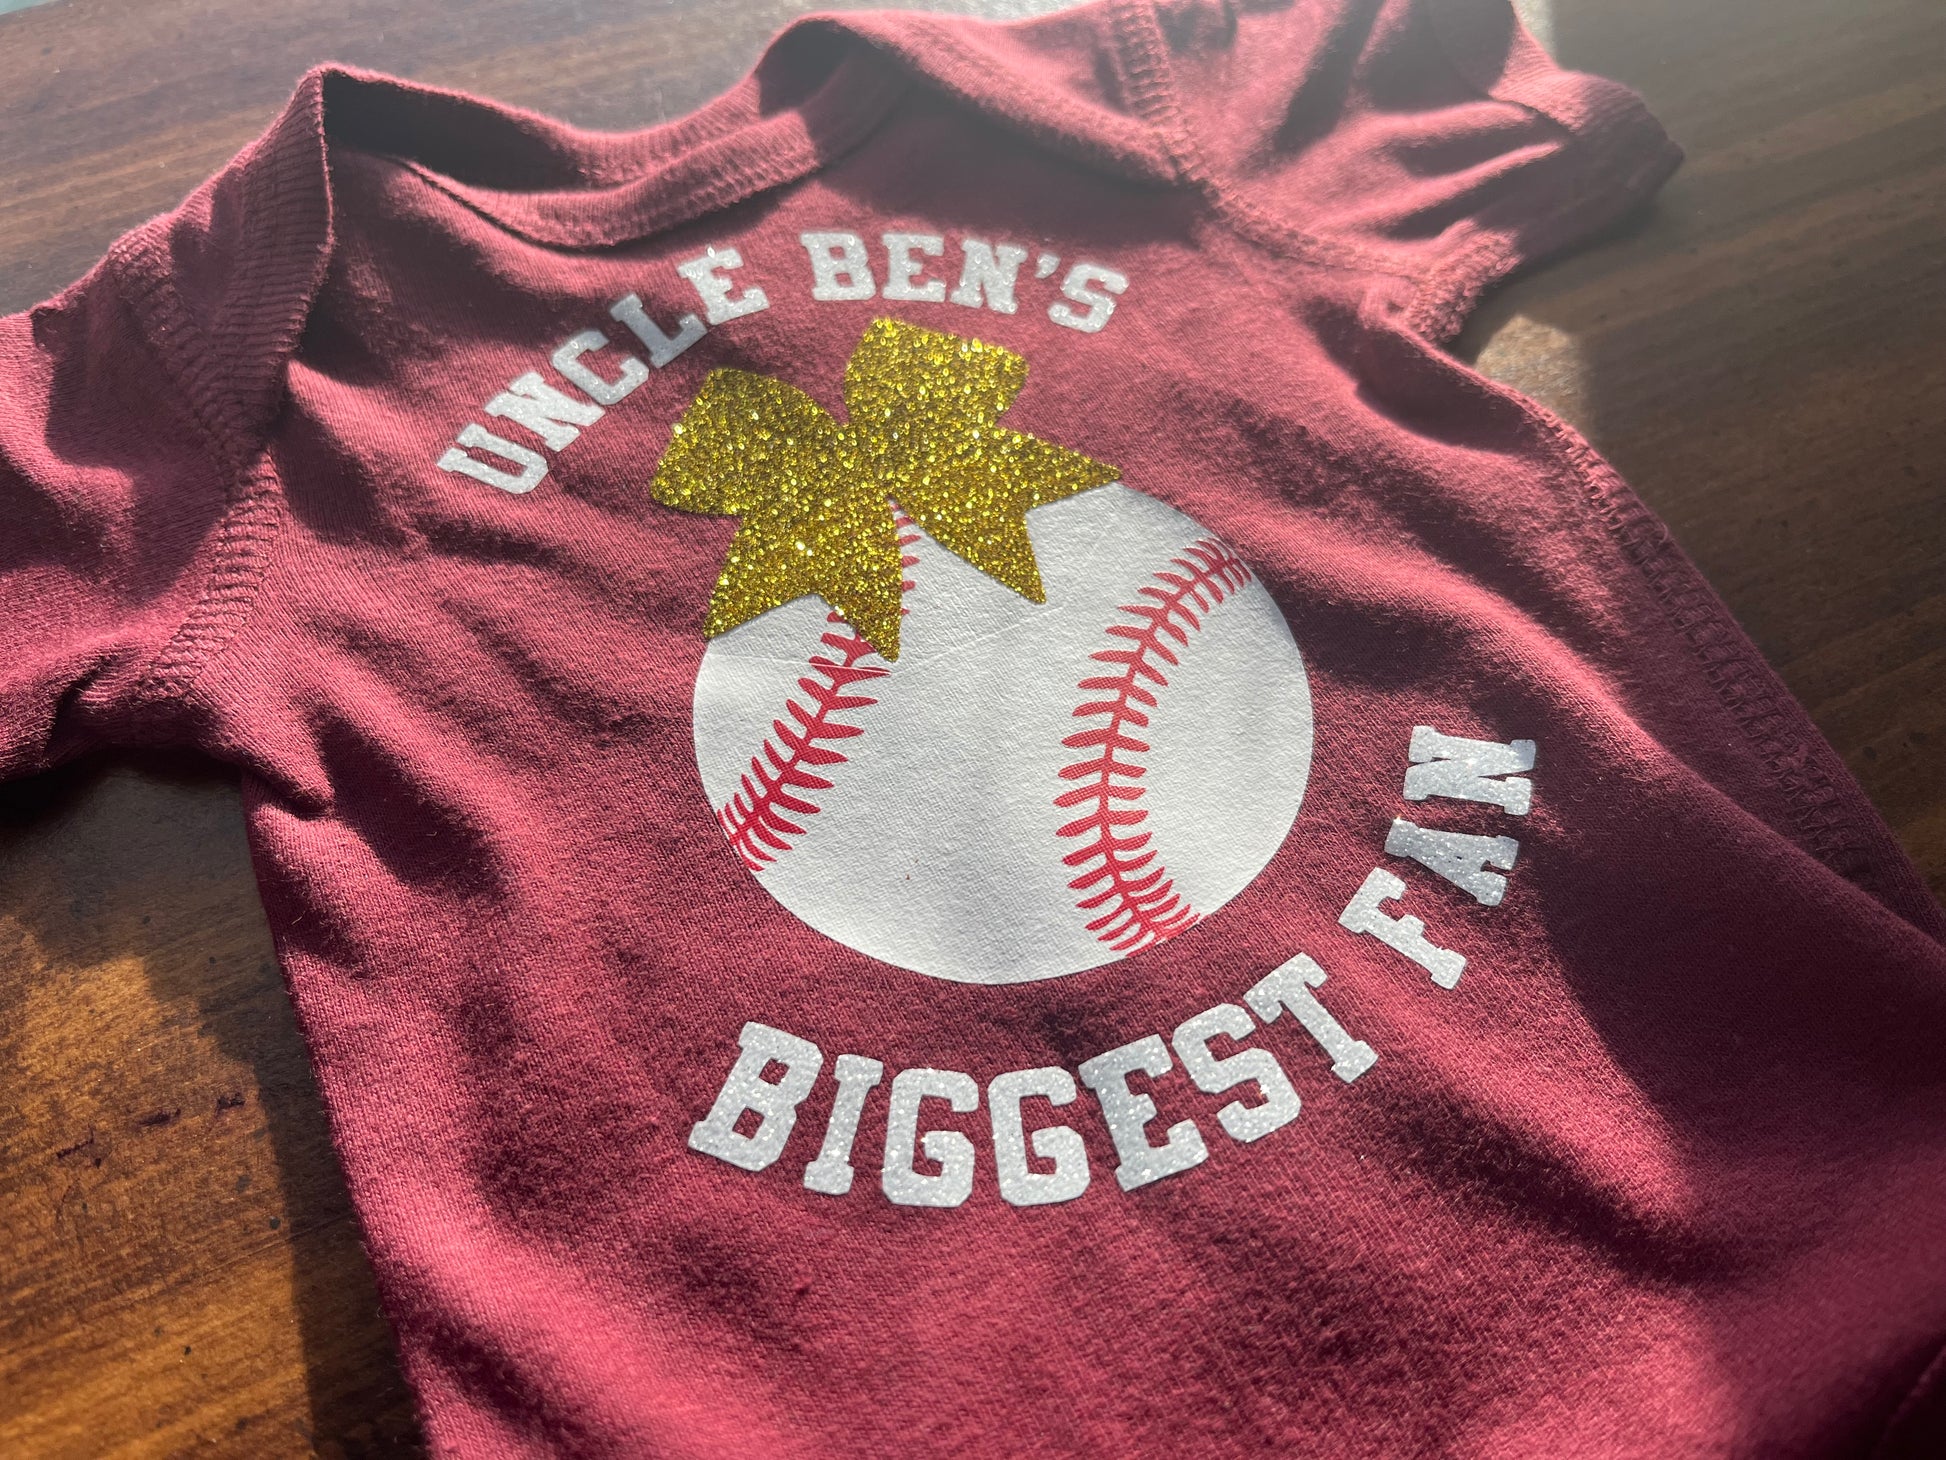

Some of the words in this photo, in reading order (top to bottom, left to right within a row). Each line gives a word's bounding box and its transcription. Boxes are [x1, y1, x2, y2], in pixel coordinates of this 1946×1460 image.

[438, 246, 770, 495] UNCLE
[800, 231, 1129, 333] BEN'S
[688, 954, 1379, 1207] BIGGEST
[1339, 725, 1536, 989] FAN
